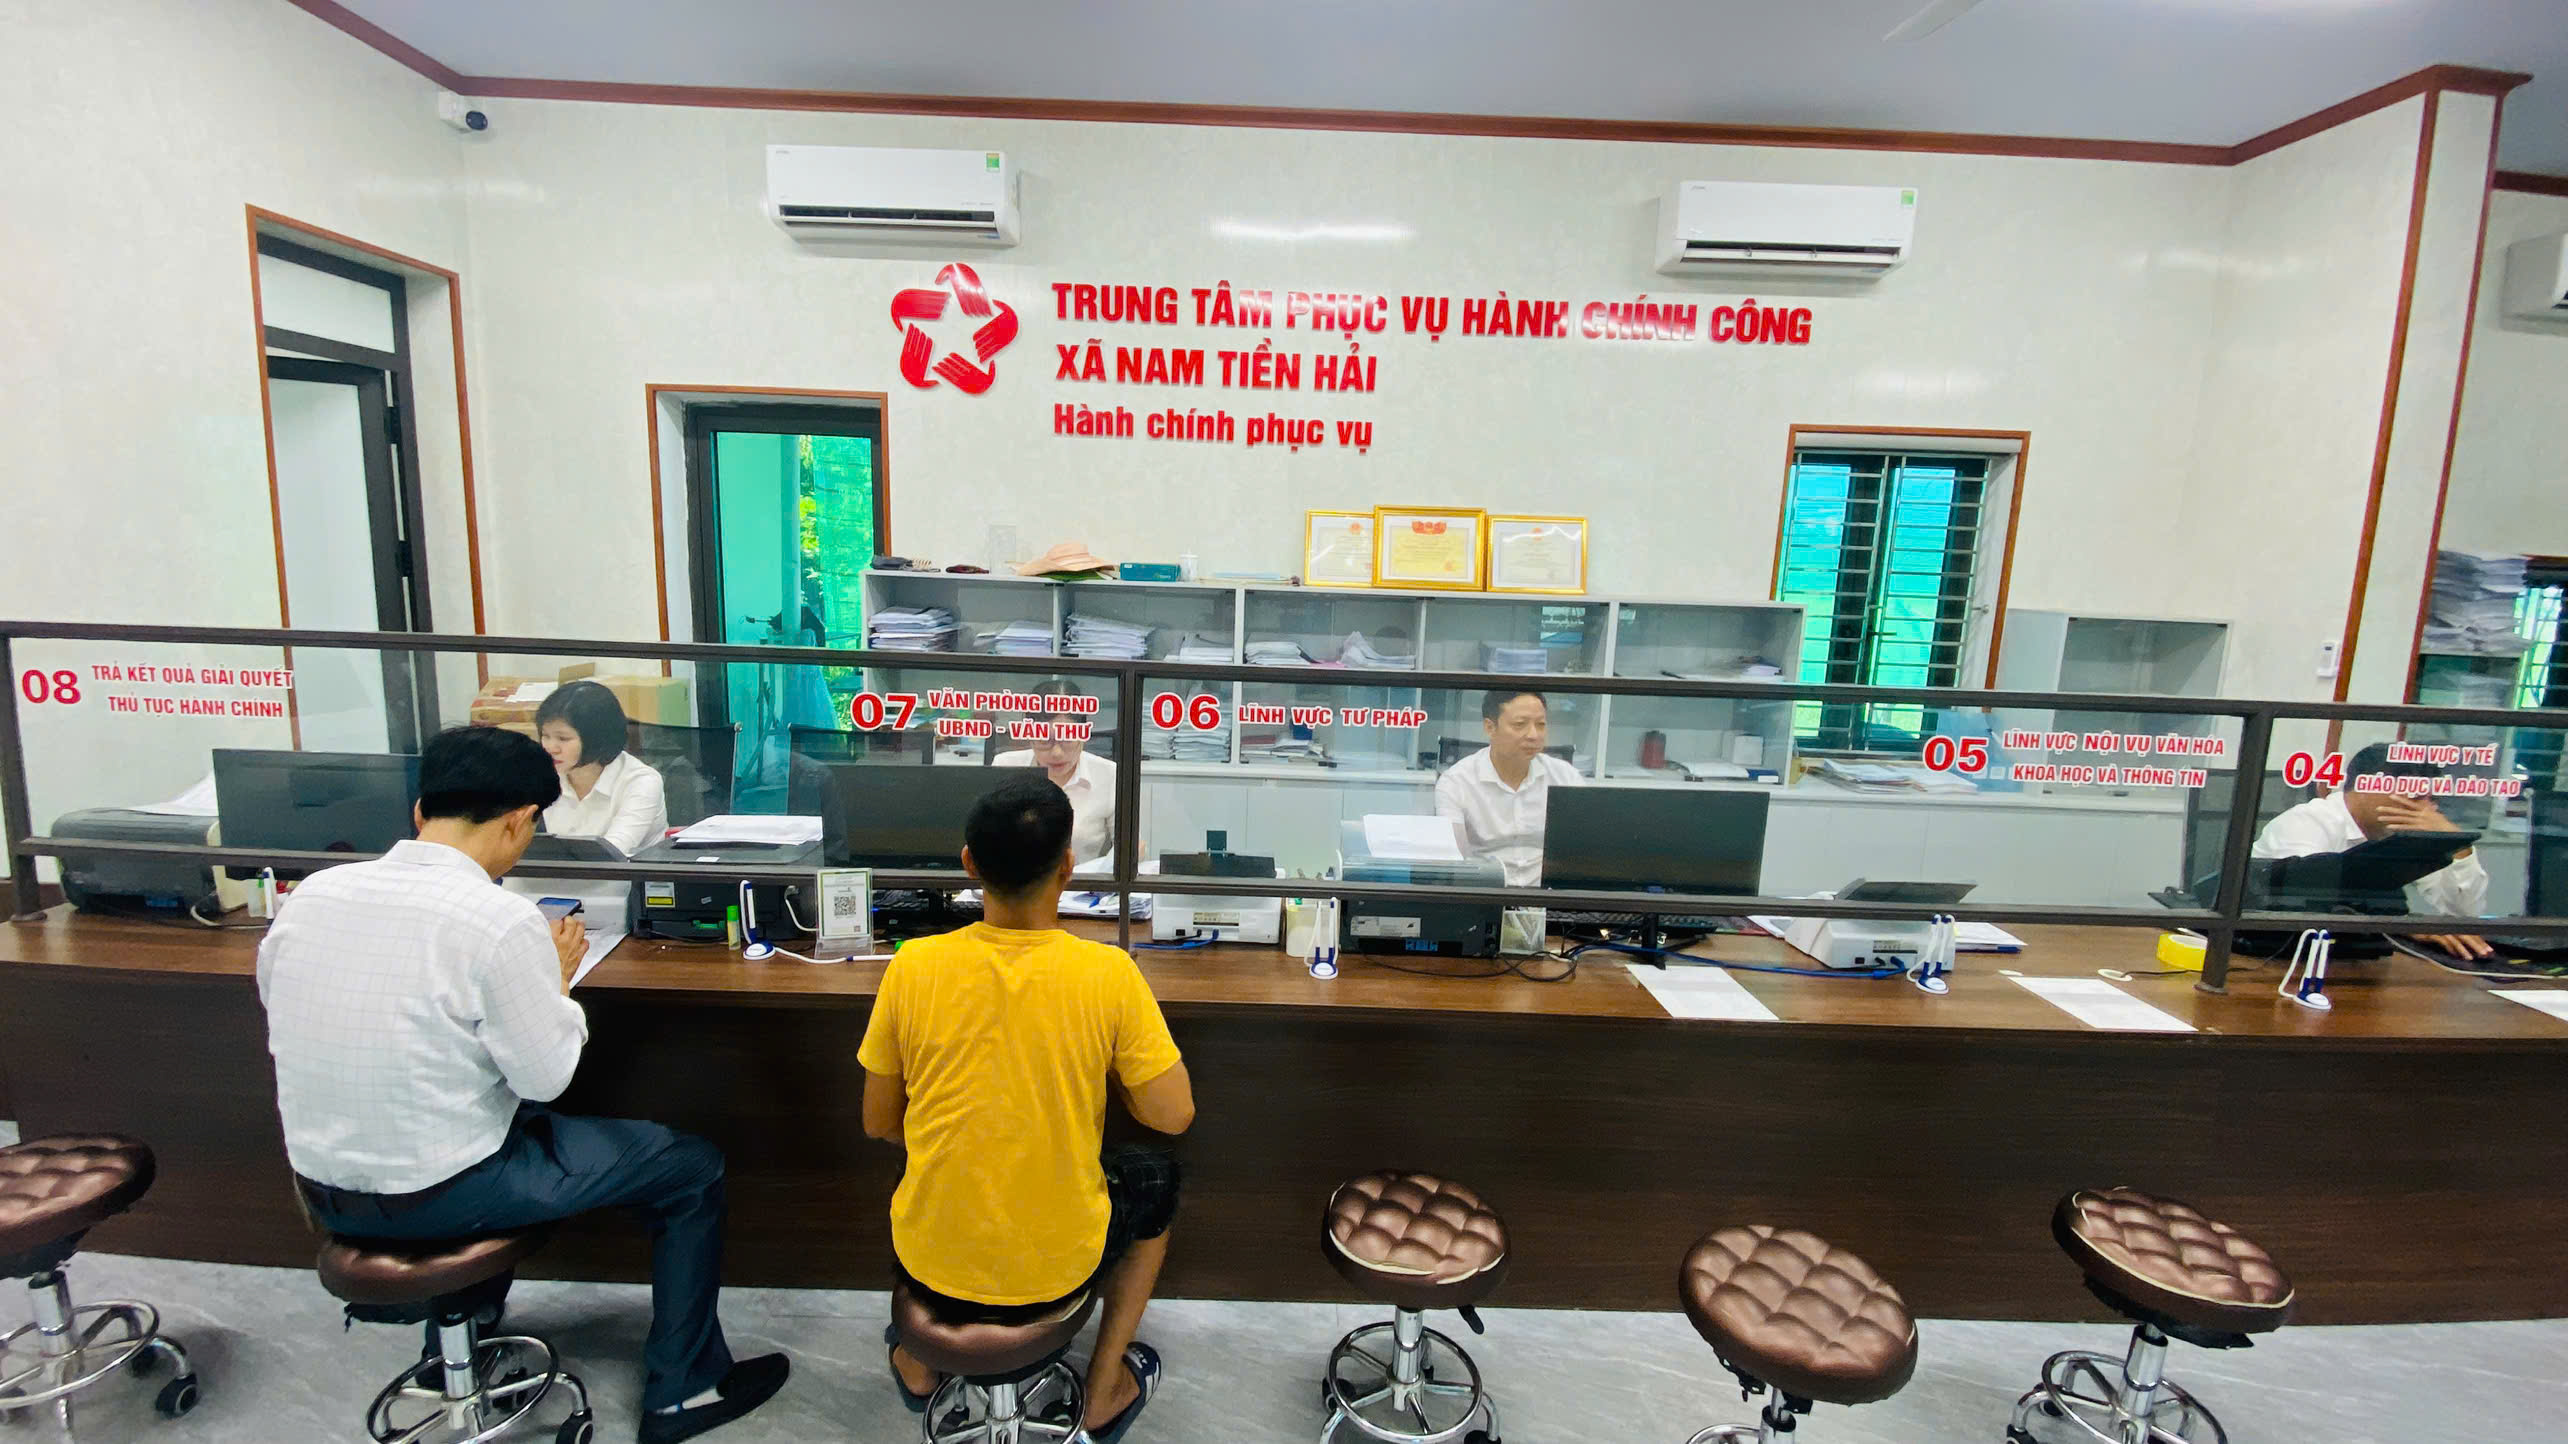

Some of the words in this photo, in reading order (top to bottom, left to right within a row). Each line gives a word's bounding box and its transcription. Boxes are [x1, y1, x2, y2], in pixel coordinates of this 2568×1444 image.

[1052, 283, 1178, 325] TRUNG
[1191, 280, 1273, 328] TÂM
[1286, 291, 1388, 340] PHỤC
[1401, 295, 1449, 342] VỤ
[1462, 291, 1569, 338] HÀNH
[1582, 294, 1697, 341] CHÍNH
[1710, 298, 1813, 345] CÔNG
[1055, 338, 1107, 383] XÃ
[1116, 347, 1204, 387] NAM
[1218, 337, 1301, 391] TIỀN
[1313, 342, 1377, 393] HẢI
[1054, 403, 1134, 438] Hành
[1146, 408, 1235, 442] chính
[1247, 412, 1325, 453] phục
[1336, 420, 1373, 455] vụ
[21, 669, 81, 705] 08
[91, 660, 122, 681] TRẢ
[127, 662, 156, 682] KẾT
[162, 662, 196, 684] QUẢ
[201, 664, 234, 685] GIẢI
[240, 666, 293, 687] QUYẾT
[108, 691, 139, 713] THỦ
[143, 697, 174, 717] TỤC
[180, 696, 225, 715] HÀNH
[231, 698, 284, 717] CHÍNH
[851, 693, 917, 730] 07
[928, 687, 969, 709] VĂN
[976, 690, 1041, 712] PHÒNG
[1046, 695, 1098, 714] HĐND
[1152, 693, 1221, 730] 06
[1239, 703, 1284, 724] LĨNH
[1292, 706, 1332, 728] VỰC
[1342, 708, 1369, 725] TƯ
[1372, 707, 1426, 727] PHÁP
[938, 719, 991, 737] UBND
[1010, 720, 1049, 739] VĂN
[1055, 722, 1092, 741] THƯ
[2003, 729, 2041, 749] LĨNH
[2045, 732, 2077, 753] VỰC
[2084, 731, 2119, 754] NỘI
[2125, 736, 2151, 756] VỤ
[2157, 733, 2189, 753] VĂN
[2192, 736, 2224, 755] HÓA
[1924, 736, 1988, 773] 05
[2389, 743, 2425, 761] LĨNH
[2430, 746, 2458, 766] VỰC
[2476, 744, 2498, 764] TẾ
[2013, 765, 2055, 781] KHOA
[2060, 767, 2093, 786] HỌC
[2098, 764, 2117, 784] VÀ
[2122, 765, 2175, 785] THÔNG
[2179, 770, 2206, 787] TIN
[2284, 751, 2345, 787] 04
[2356, 773, 2394, 793] GIÁO
[2398, 778, 2429, 797] DỤC
[2433, 775, 2452, 793] VÀ
